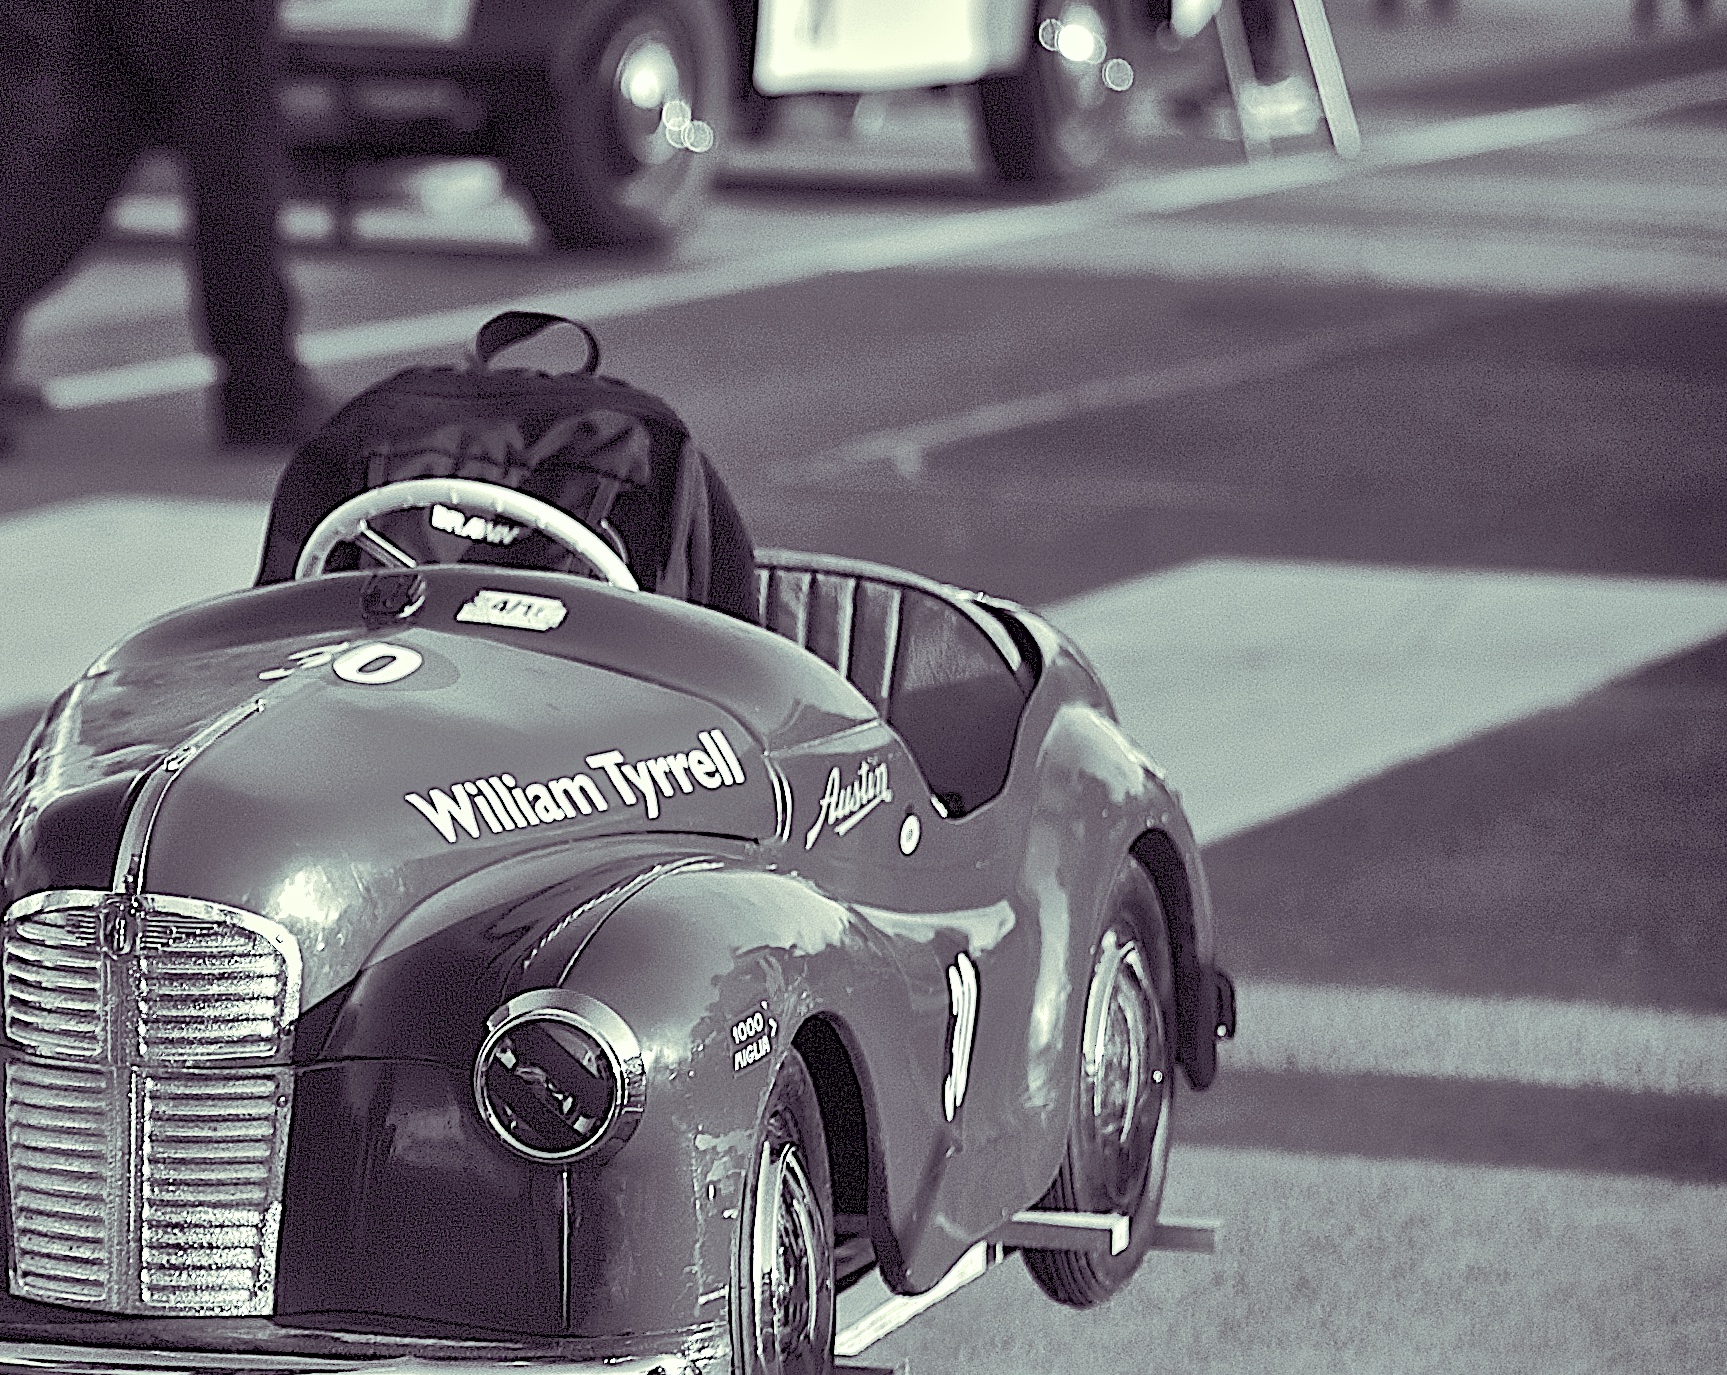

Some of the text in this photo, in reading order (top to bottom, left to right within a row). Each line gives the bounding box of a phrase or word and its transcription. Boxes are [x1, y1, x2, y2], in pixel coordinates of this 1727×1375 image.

[404, 729, 746, 843] William Tyrrell
[805, 756, 892, 850] Austin
[733, 1012, 764, 1044] 1000
